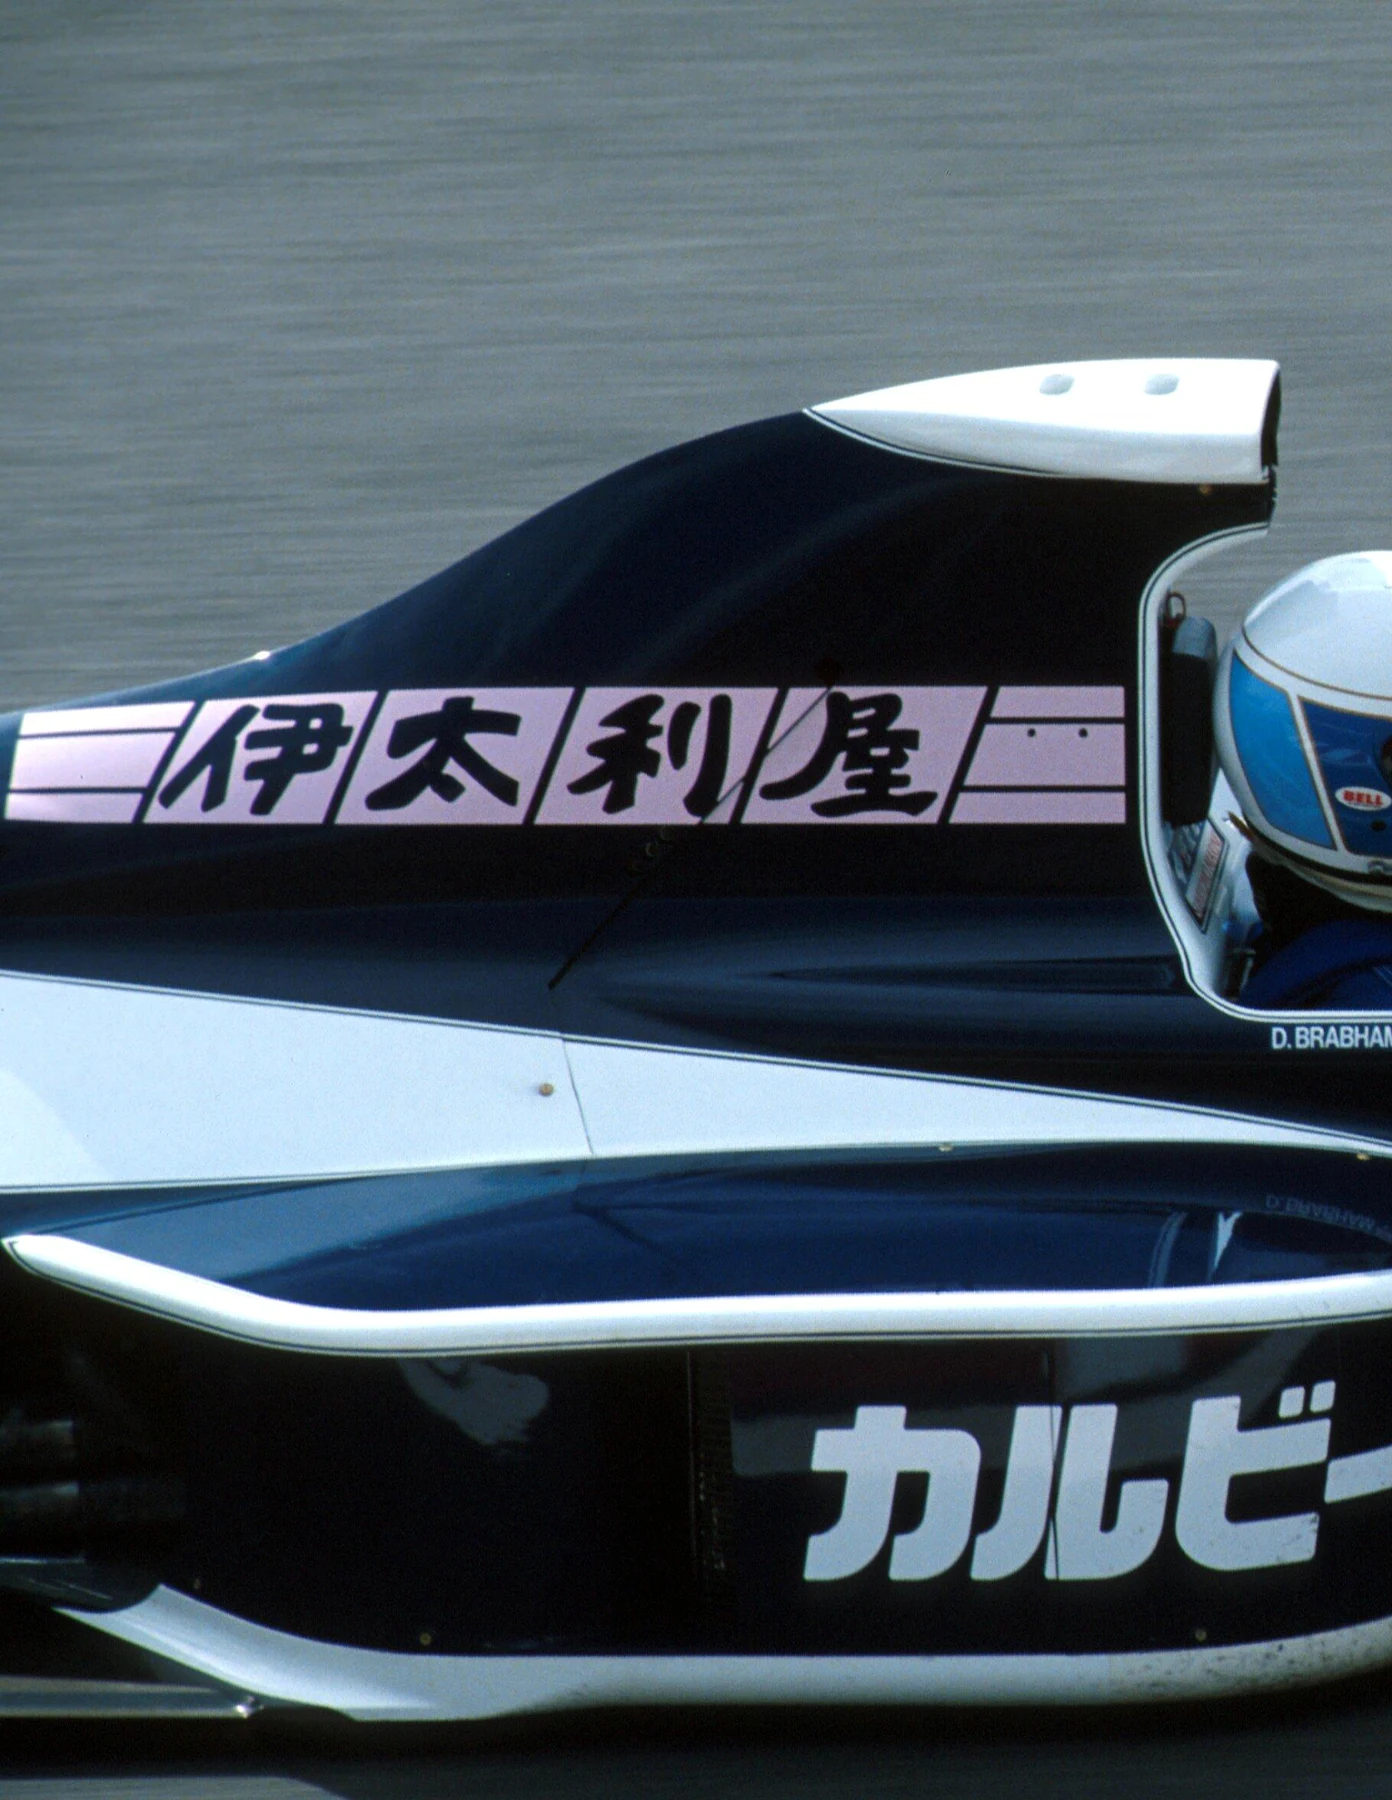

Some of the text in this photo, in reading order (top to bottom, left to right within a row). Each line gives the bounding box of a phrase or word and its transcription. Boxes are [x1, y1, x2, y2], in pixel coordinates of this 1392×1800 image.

[157, 691, 939, 817] 伊太利屋
[1342, 790, 1384, 807] BELL
